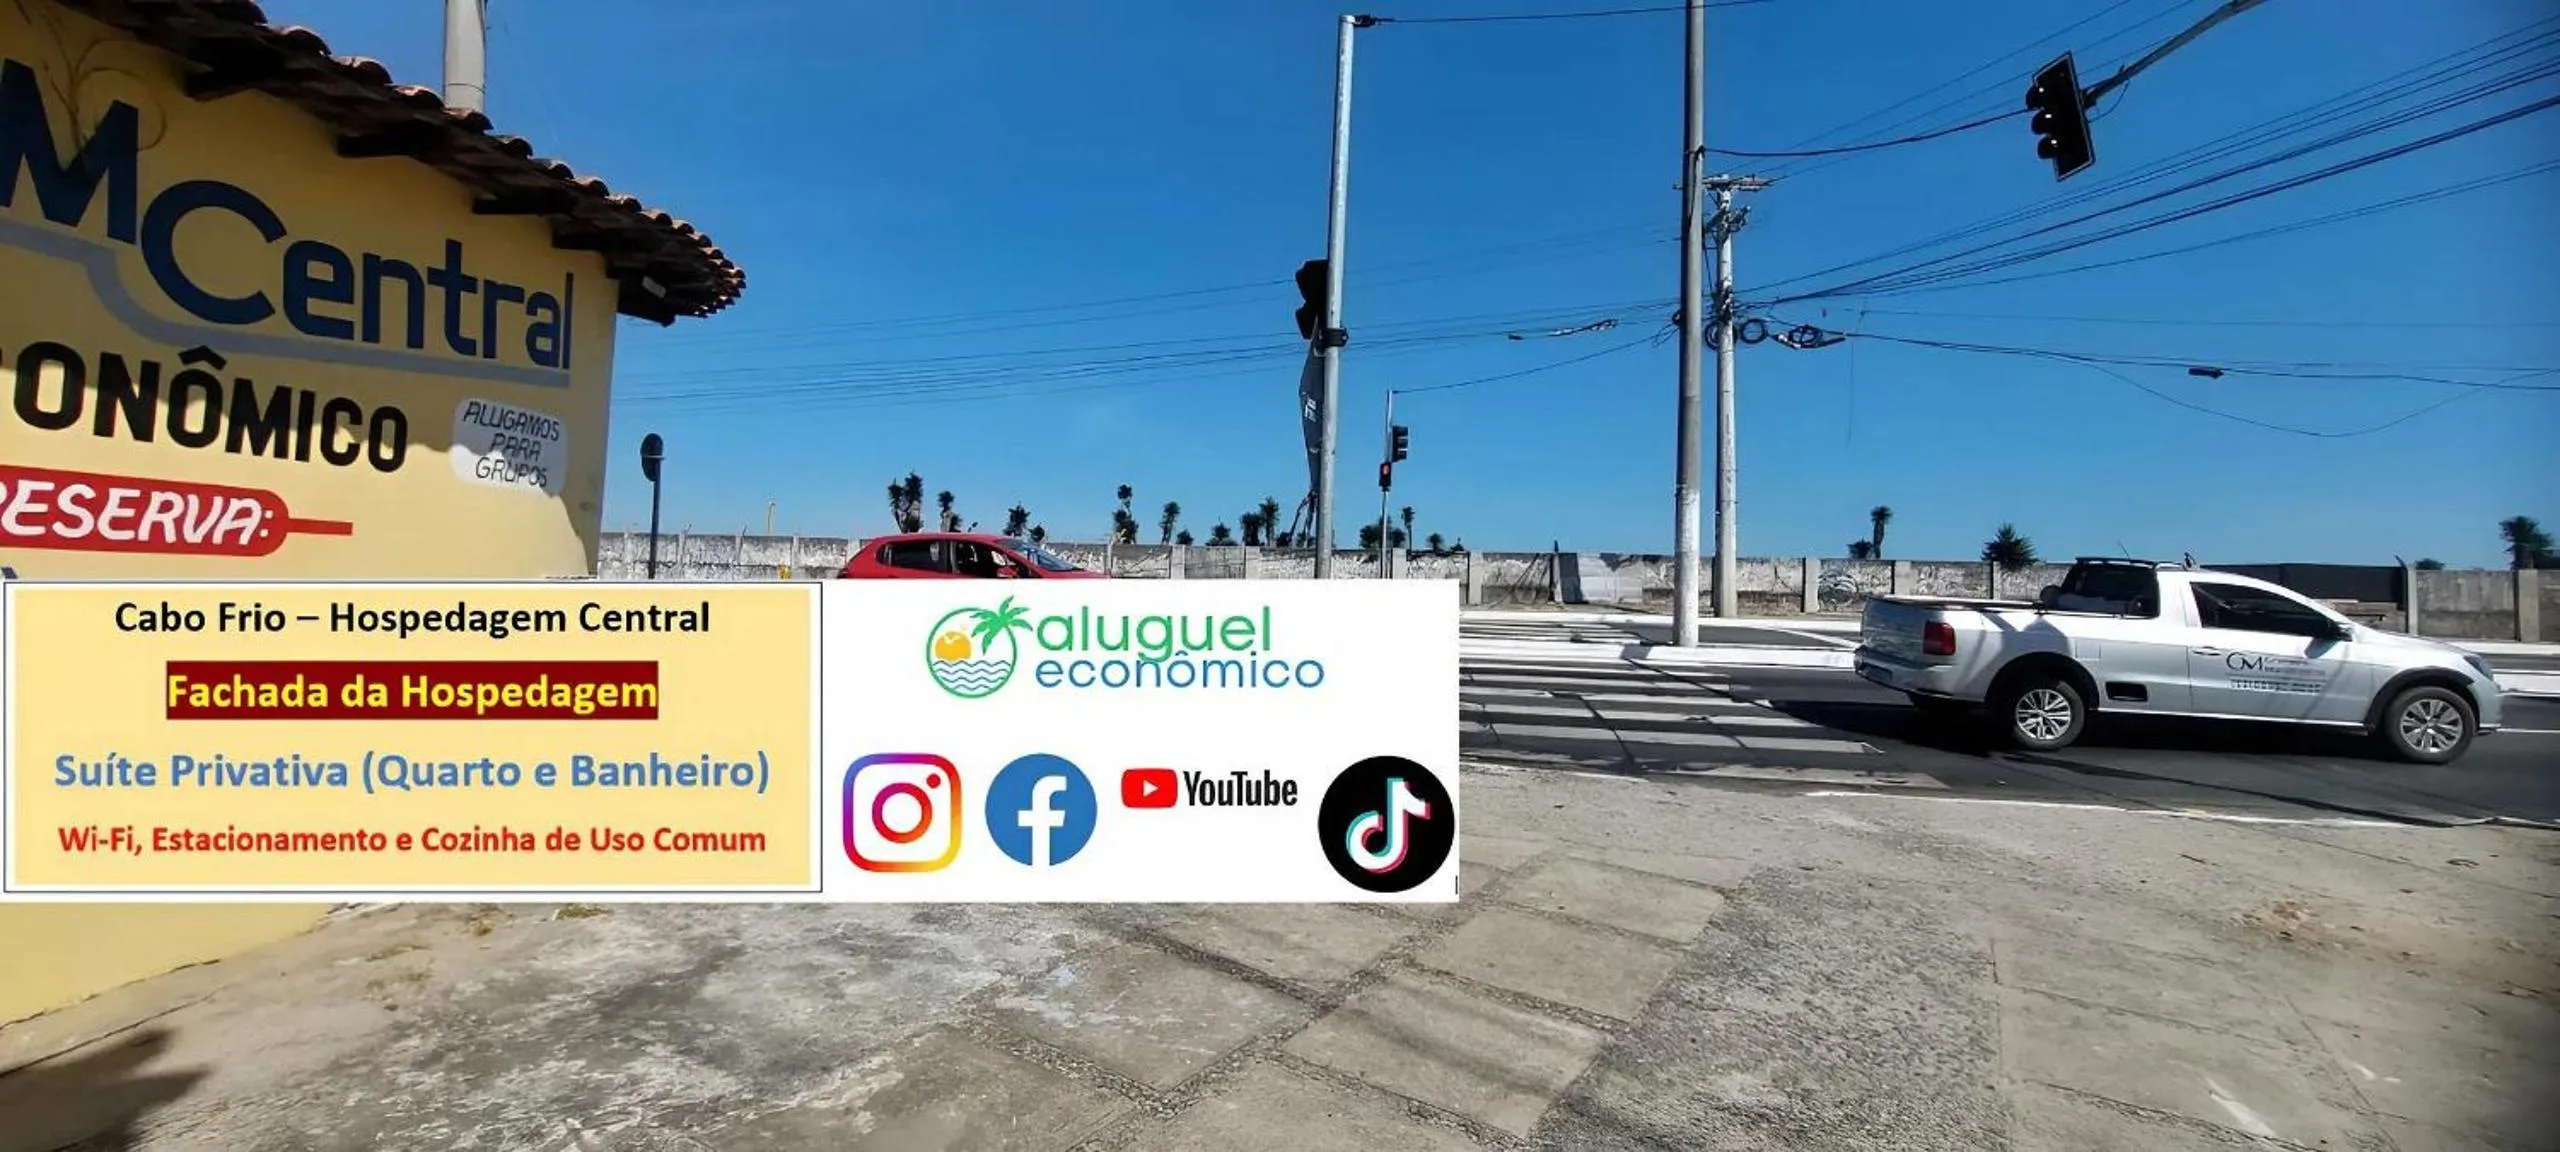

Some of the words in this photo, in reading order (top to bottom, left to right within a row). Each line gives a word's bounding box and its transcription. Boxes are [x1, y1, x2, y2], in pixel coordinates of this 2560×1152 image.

[0, 341, 408, 473] ONÔMICO
[463, 401, 560, 441] ALUGAMOS
[490, 432, 542, 461] PARA
[476, 456, 548, 488] GRUPOS
[0, 479, 273, 546] ESERVA:
